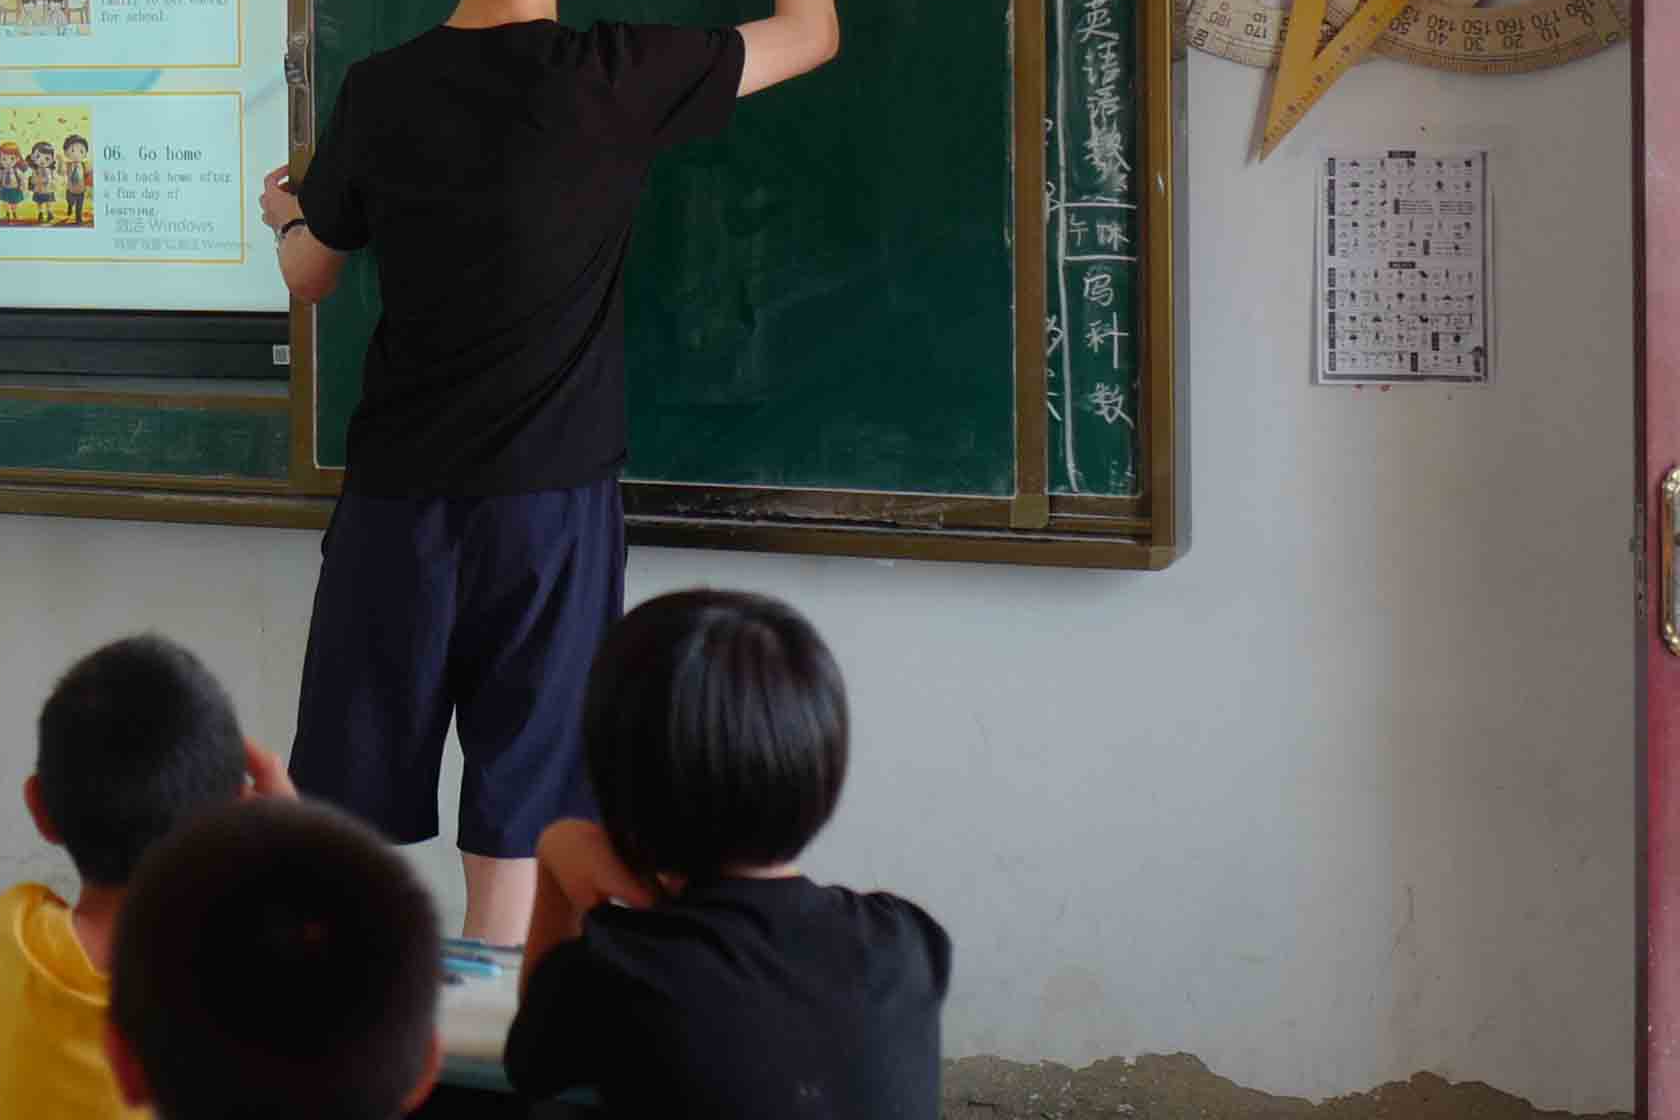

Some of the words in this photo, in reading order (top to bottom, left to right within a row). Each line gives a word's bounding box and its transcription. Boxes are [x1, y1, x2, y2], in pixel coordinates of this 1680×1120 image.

[138, 145, 158, 161] Go
[165, 144, 203, 161] home
[149, 218, 216, 234] Windows
